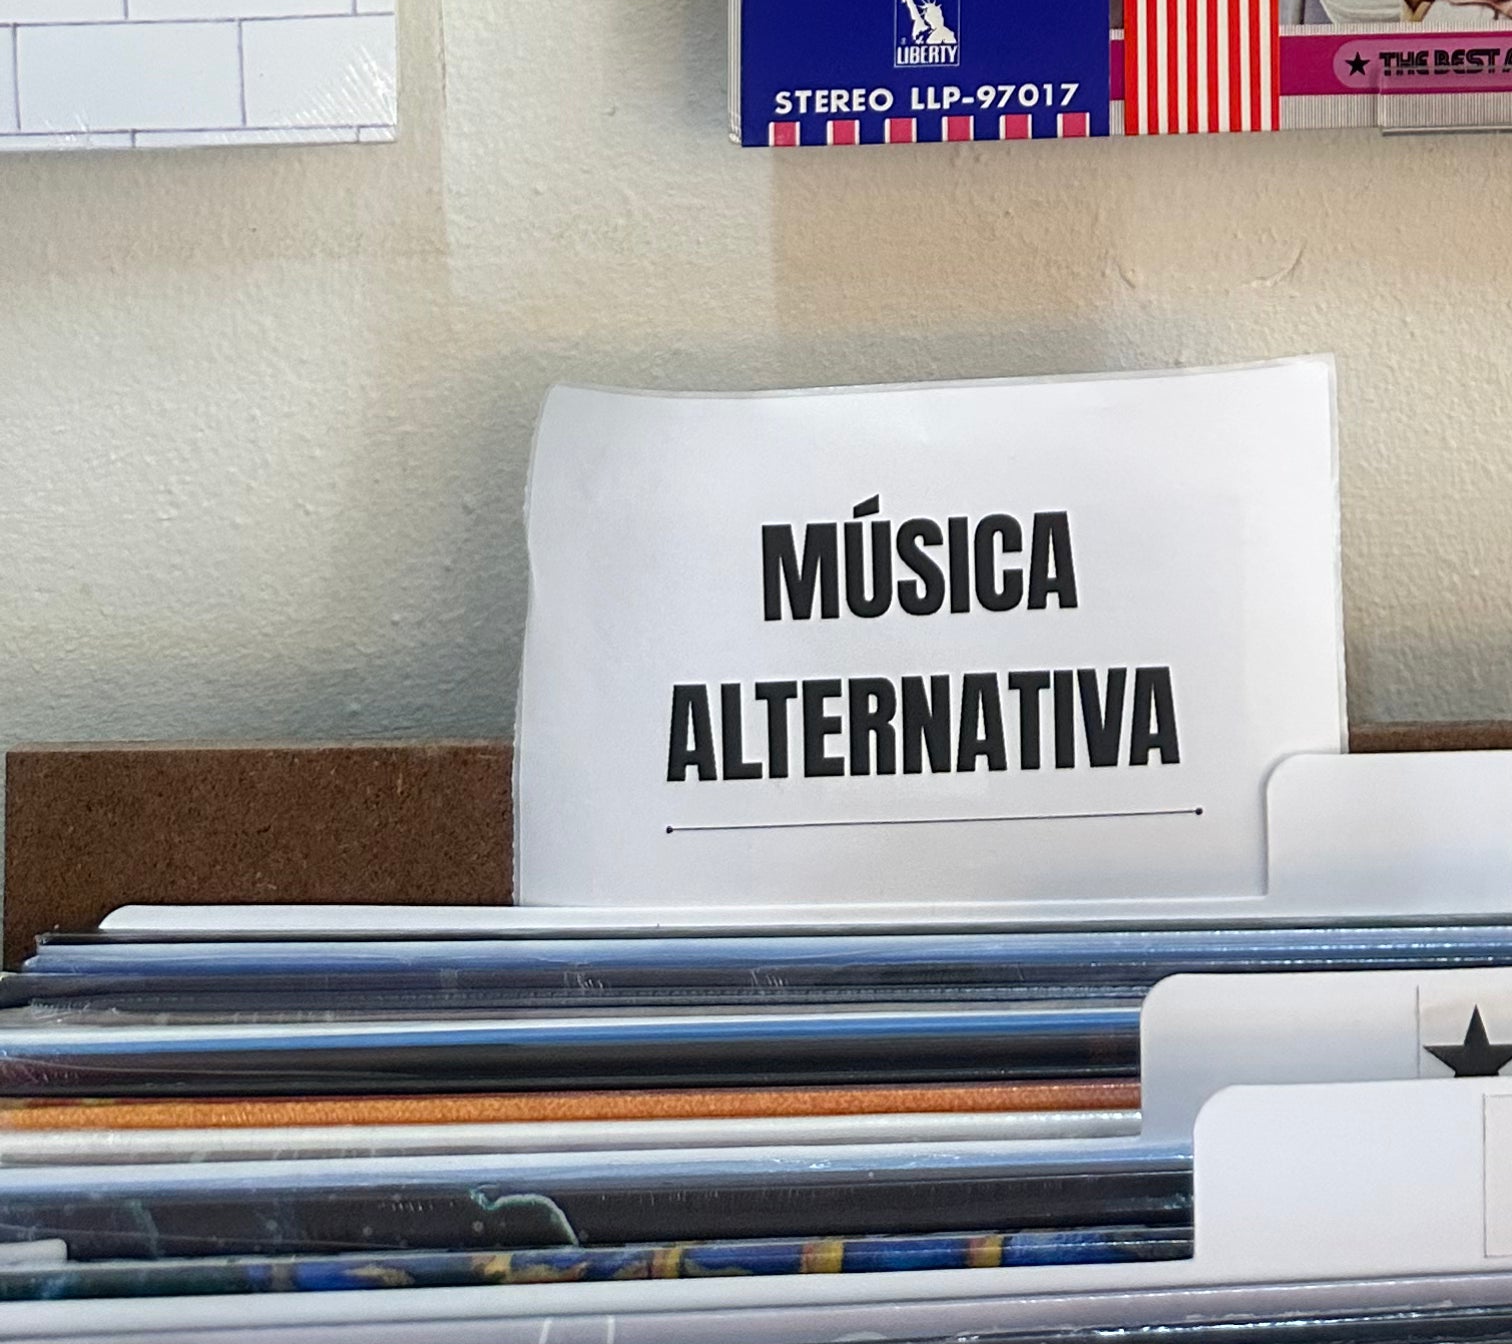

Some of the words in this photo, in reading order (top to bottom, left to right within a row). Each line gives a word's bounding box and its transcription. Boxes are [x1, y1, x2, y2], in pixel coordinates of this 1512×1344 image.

[897, 45, 958, 65] LIBERTY
[1379, 51, 1430, 76] THE
[1434, 48, 1500, 75] BEST
[775, 88, 894, 114] STEREO
[911, 83, 1079, 111] LLP-97017
[761, 493, 1078, 621] MÚSICA
[666, 666, 1180, 782] ALTERNATIVA
